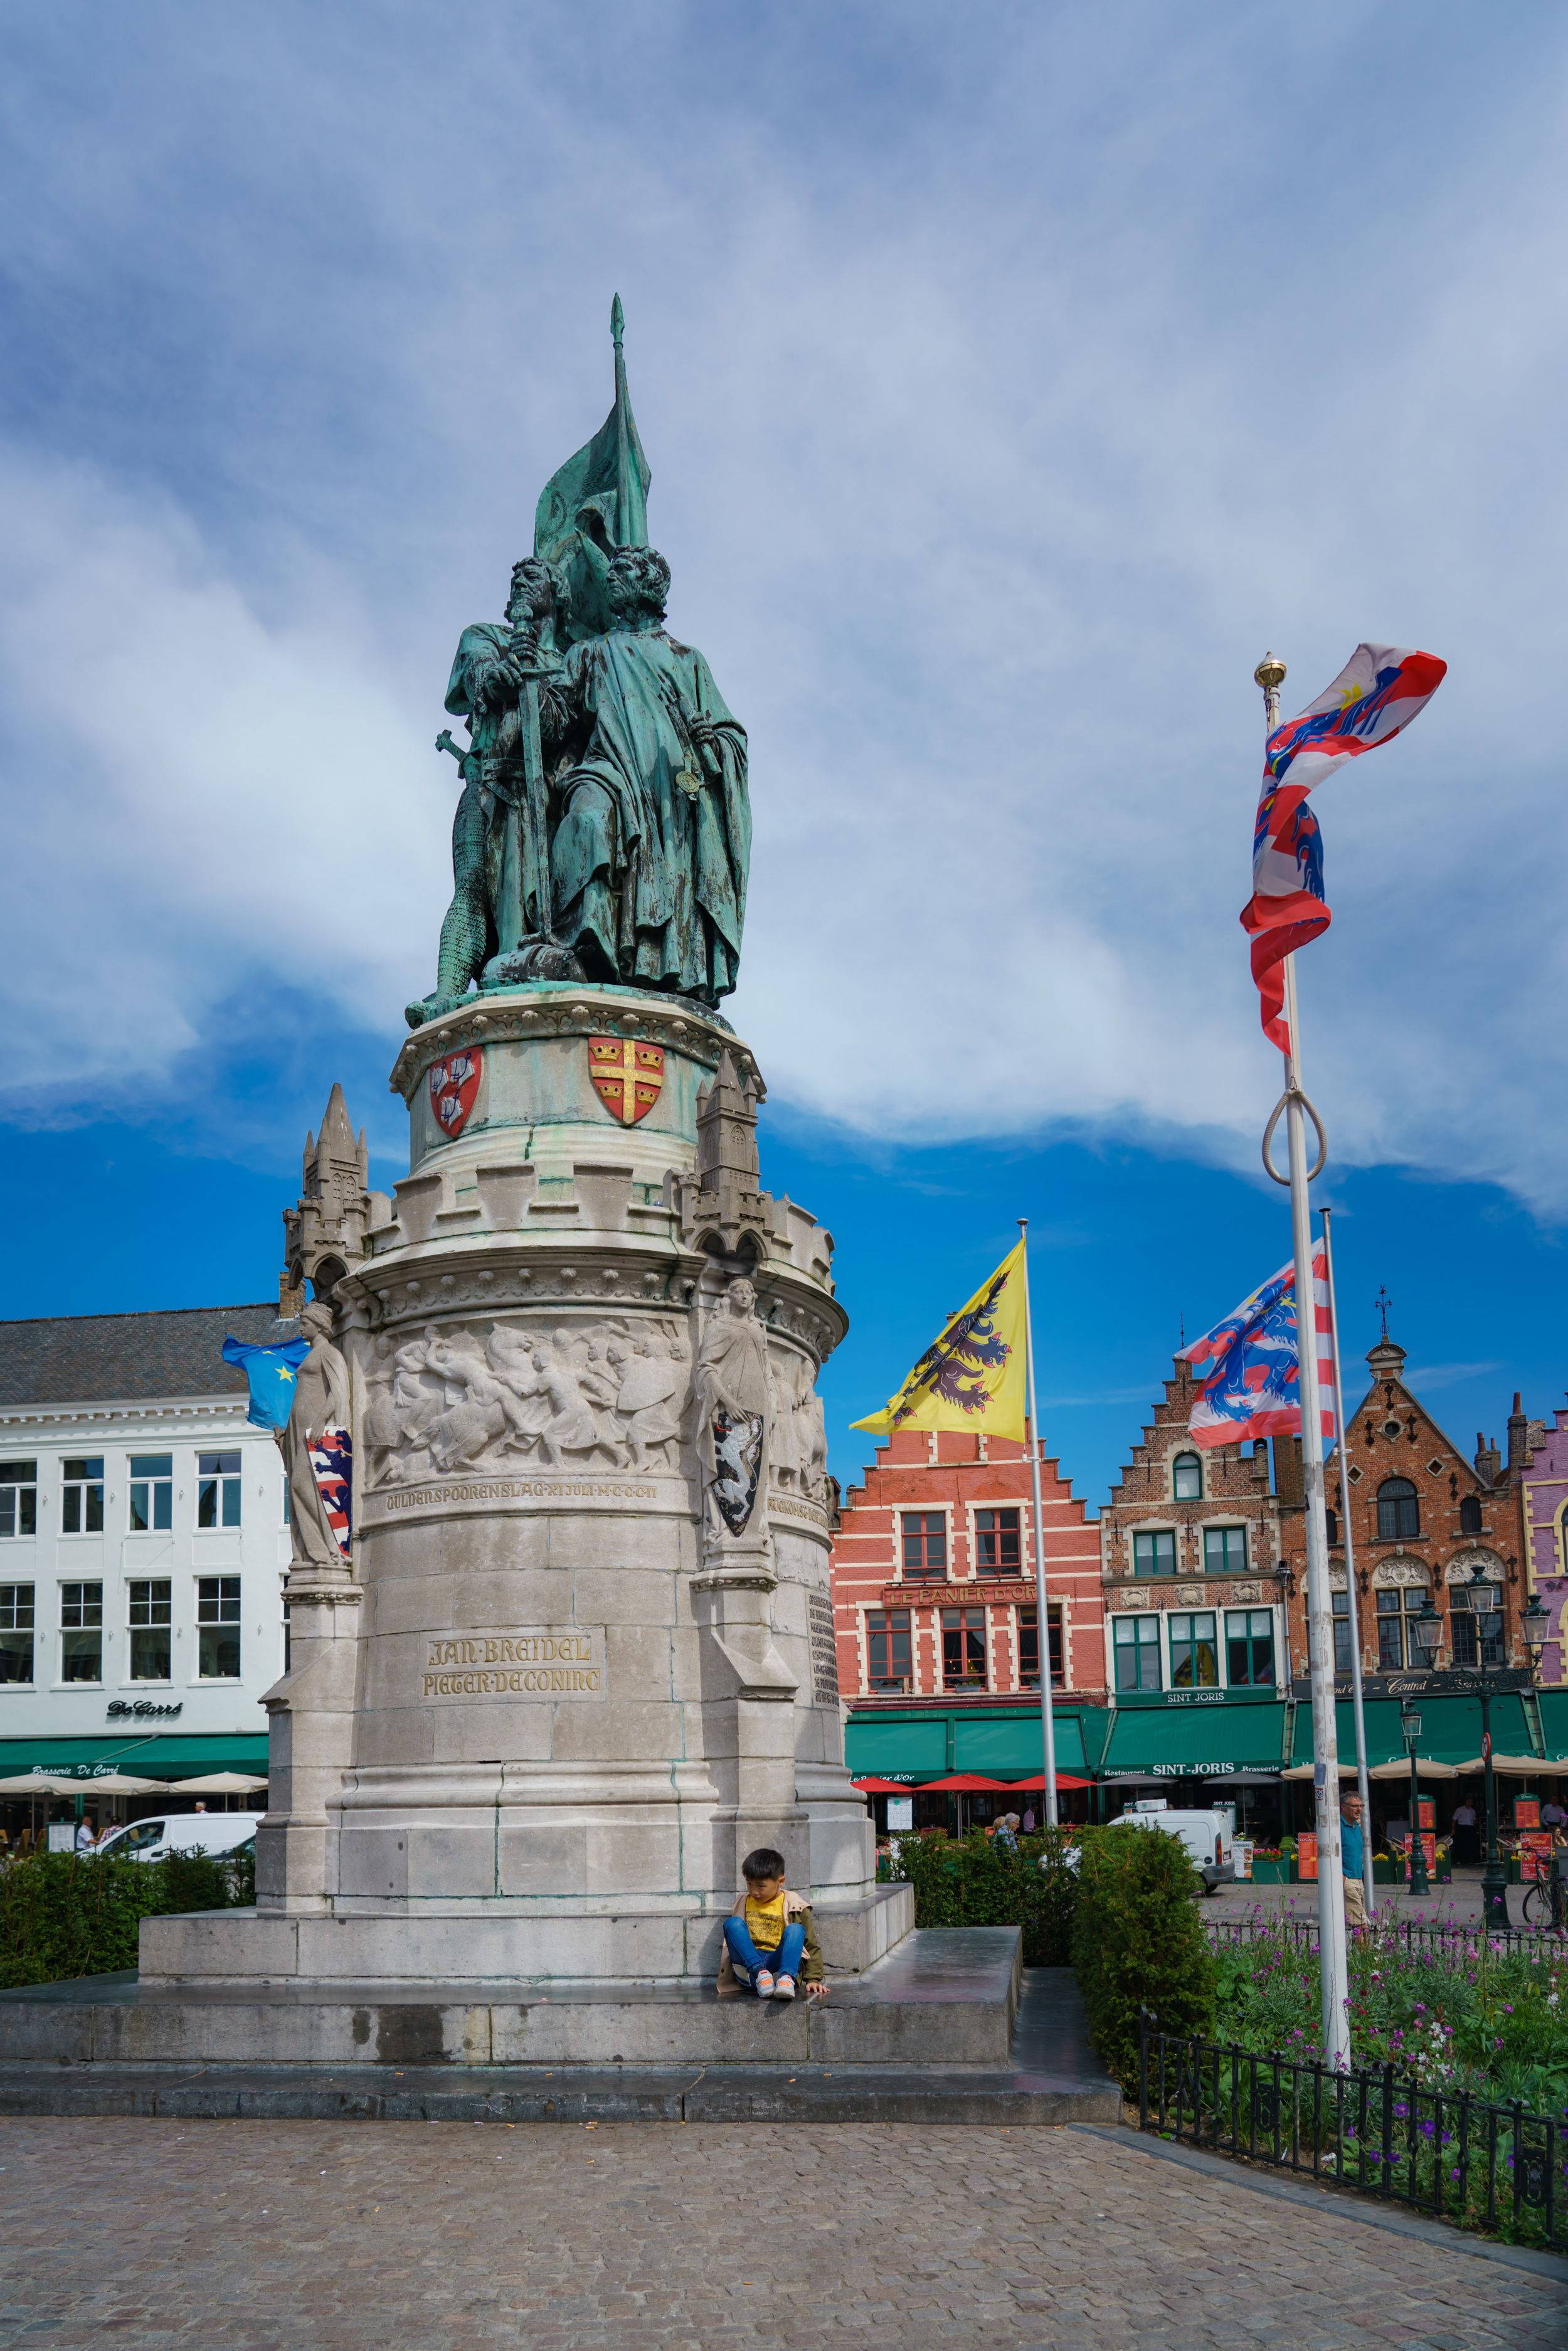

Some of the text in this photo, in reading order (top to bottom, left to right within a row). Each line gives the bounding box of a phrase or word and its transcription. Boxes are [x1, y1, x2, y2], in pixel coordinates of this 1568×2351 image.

[890, 1585, 1037, 1605] LE PANIER D'OR
[428, 1637, 591, 1667] JAN BREIDEL
[423, 1671, 492, 1696] PIETER
[1387, 1678, 1428, 1694] Central
[1167, 1692, 1224, 1702] SINT JORIS
[107, 1701, 184, 1716] De Carré
[32, 1764, 120, 1776] Brasserie De Carré
[1153, 1763, 1235, 1775] SINT-JORIS
